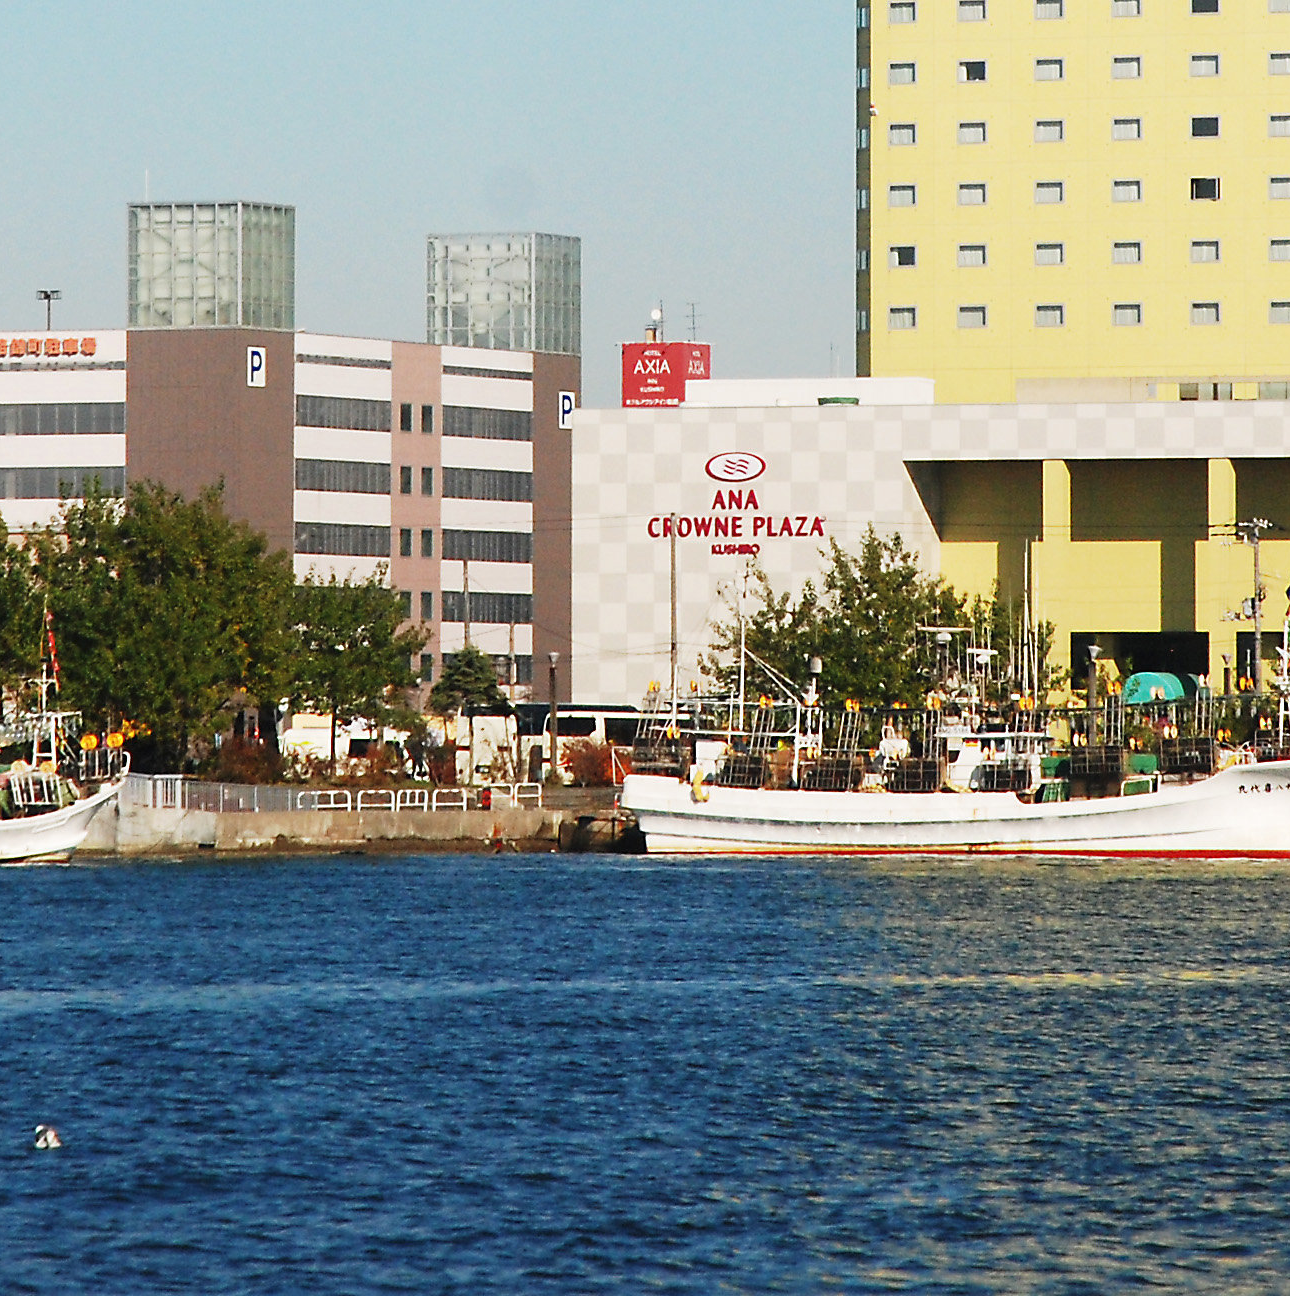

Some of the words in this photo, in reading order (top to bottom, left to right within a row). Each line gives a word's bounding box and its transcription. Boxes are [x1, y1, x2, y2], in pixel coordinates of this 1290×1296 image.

[251, 350, 262, 382] P
[634, 359, 671, 374] AXIA
[688, 360, 705, 375] AXIA
[562, 394, 572, 425] P
[712, 489, 759, 510] ANA
[647, 516, 743, 538] CROWNE
[753, 516, 824, 537] PLAZA
[711, 543, 760, 556] KUSHIRO
